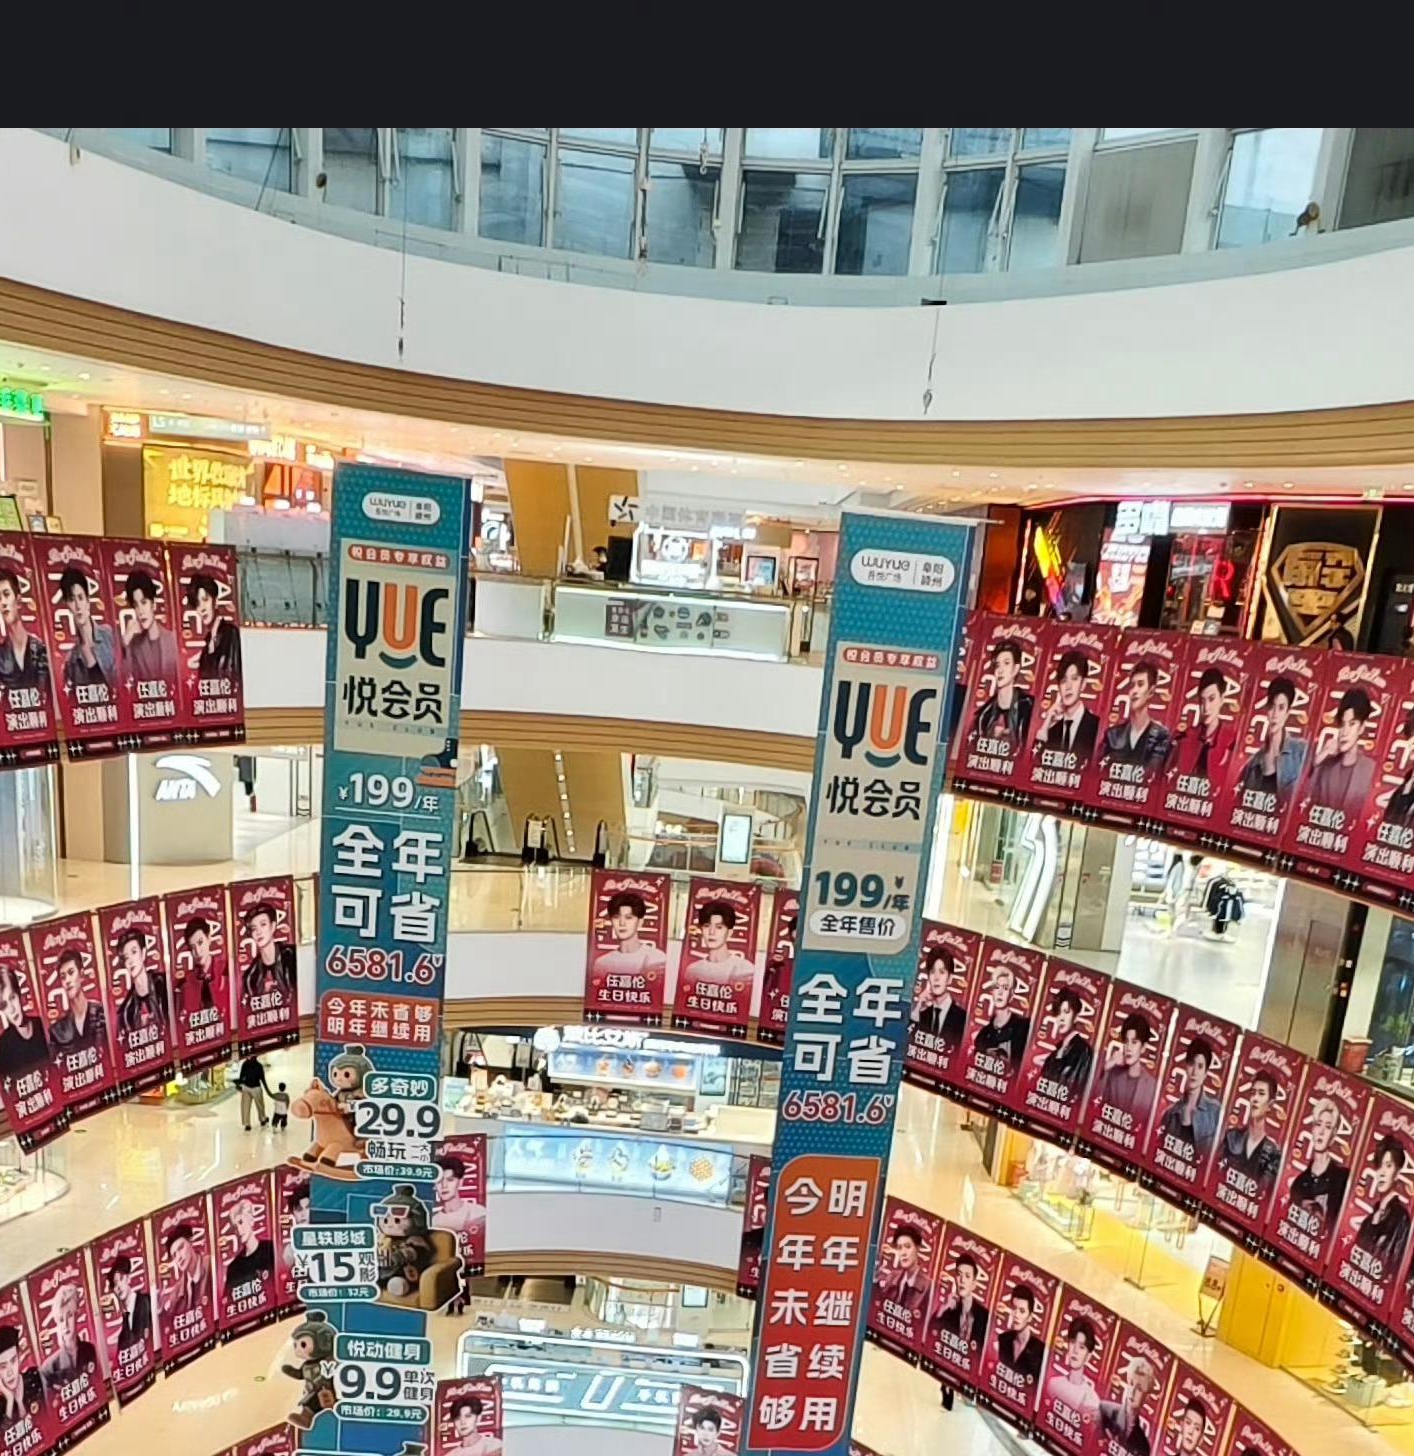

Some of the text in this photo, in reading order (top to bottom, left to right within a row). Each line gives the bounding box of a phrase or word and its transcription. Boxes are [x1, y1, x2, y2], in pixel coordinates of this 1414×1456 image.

[344, 577, 450, 668] YUE
[198, 677, 232, 697] 任嘉伦
[342, 674, 444, 725] 悦会员
[193, 697, 238, 716] 演出顺利
[832, 680, 938, 765] YUE
[1041, 748, 1079, 770] 任嘉伦
[1030, 766, 1081, 789] 演出顺利
[1175, 775, 1212, 797] 任嘉伦
[825, 775, 922, 821] 悦会员
[1164, 793, 1214, 818] 演出顺利
[1376, 822, 1414, 851] 任嘉伦
[332, 822, 445, 884] 全年
[330, 883, 441, 944] 可省
[820, 914, 896, 937] 全年售价
[605, 973, 646, 989] 任嘉伦
[249, 991, 284, 1012] 任嘉伦
[598, 988, 651, 1004] 生日快乐
[796, 973, 907, 1029] 全年
[246, 1006, 291, 1031] 演出顺利
[327, 997, 434, 1023] 今年未省够
[326, 1016, 432, 1043] 明年继续用
[915, 1029, 946, 1052] 任嘉伦
[792, 1031, 897, 1084] 可省
[907, 1044, 948, 1070] 演出顺利
[370, 1077, 429, 1097] 多奇妙
[368, 1140, 407, 1160] 畅玩
[1225, 1167, 1259, 1197] 任嘉伦
[1215, 1186, 1259, 1219] 演出顺利
[758, 1176, 824, 1433] 今年未省够
[798, 1178, 868, 1433] 明年继续用
[882, 1299, 912, 1323] 任嘉伦
[876, 1312, 916, 1339] 生日快乐
[347, 1338, 422, 1361] 悦动健身
[403, 1368, 436, 1385] 单次
[403, 1385, 434, 1402] 健身
